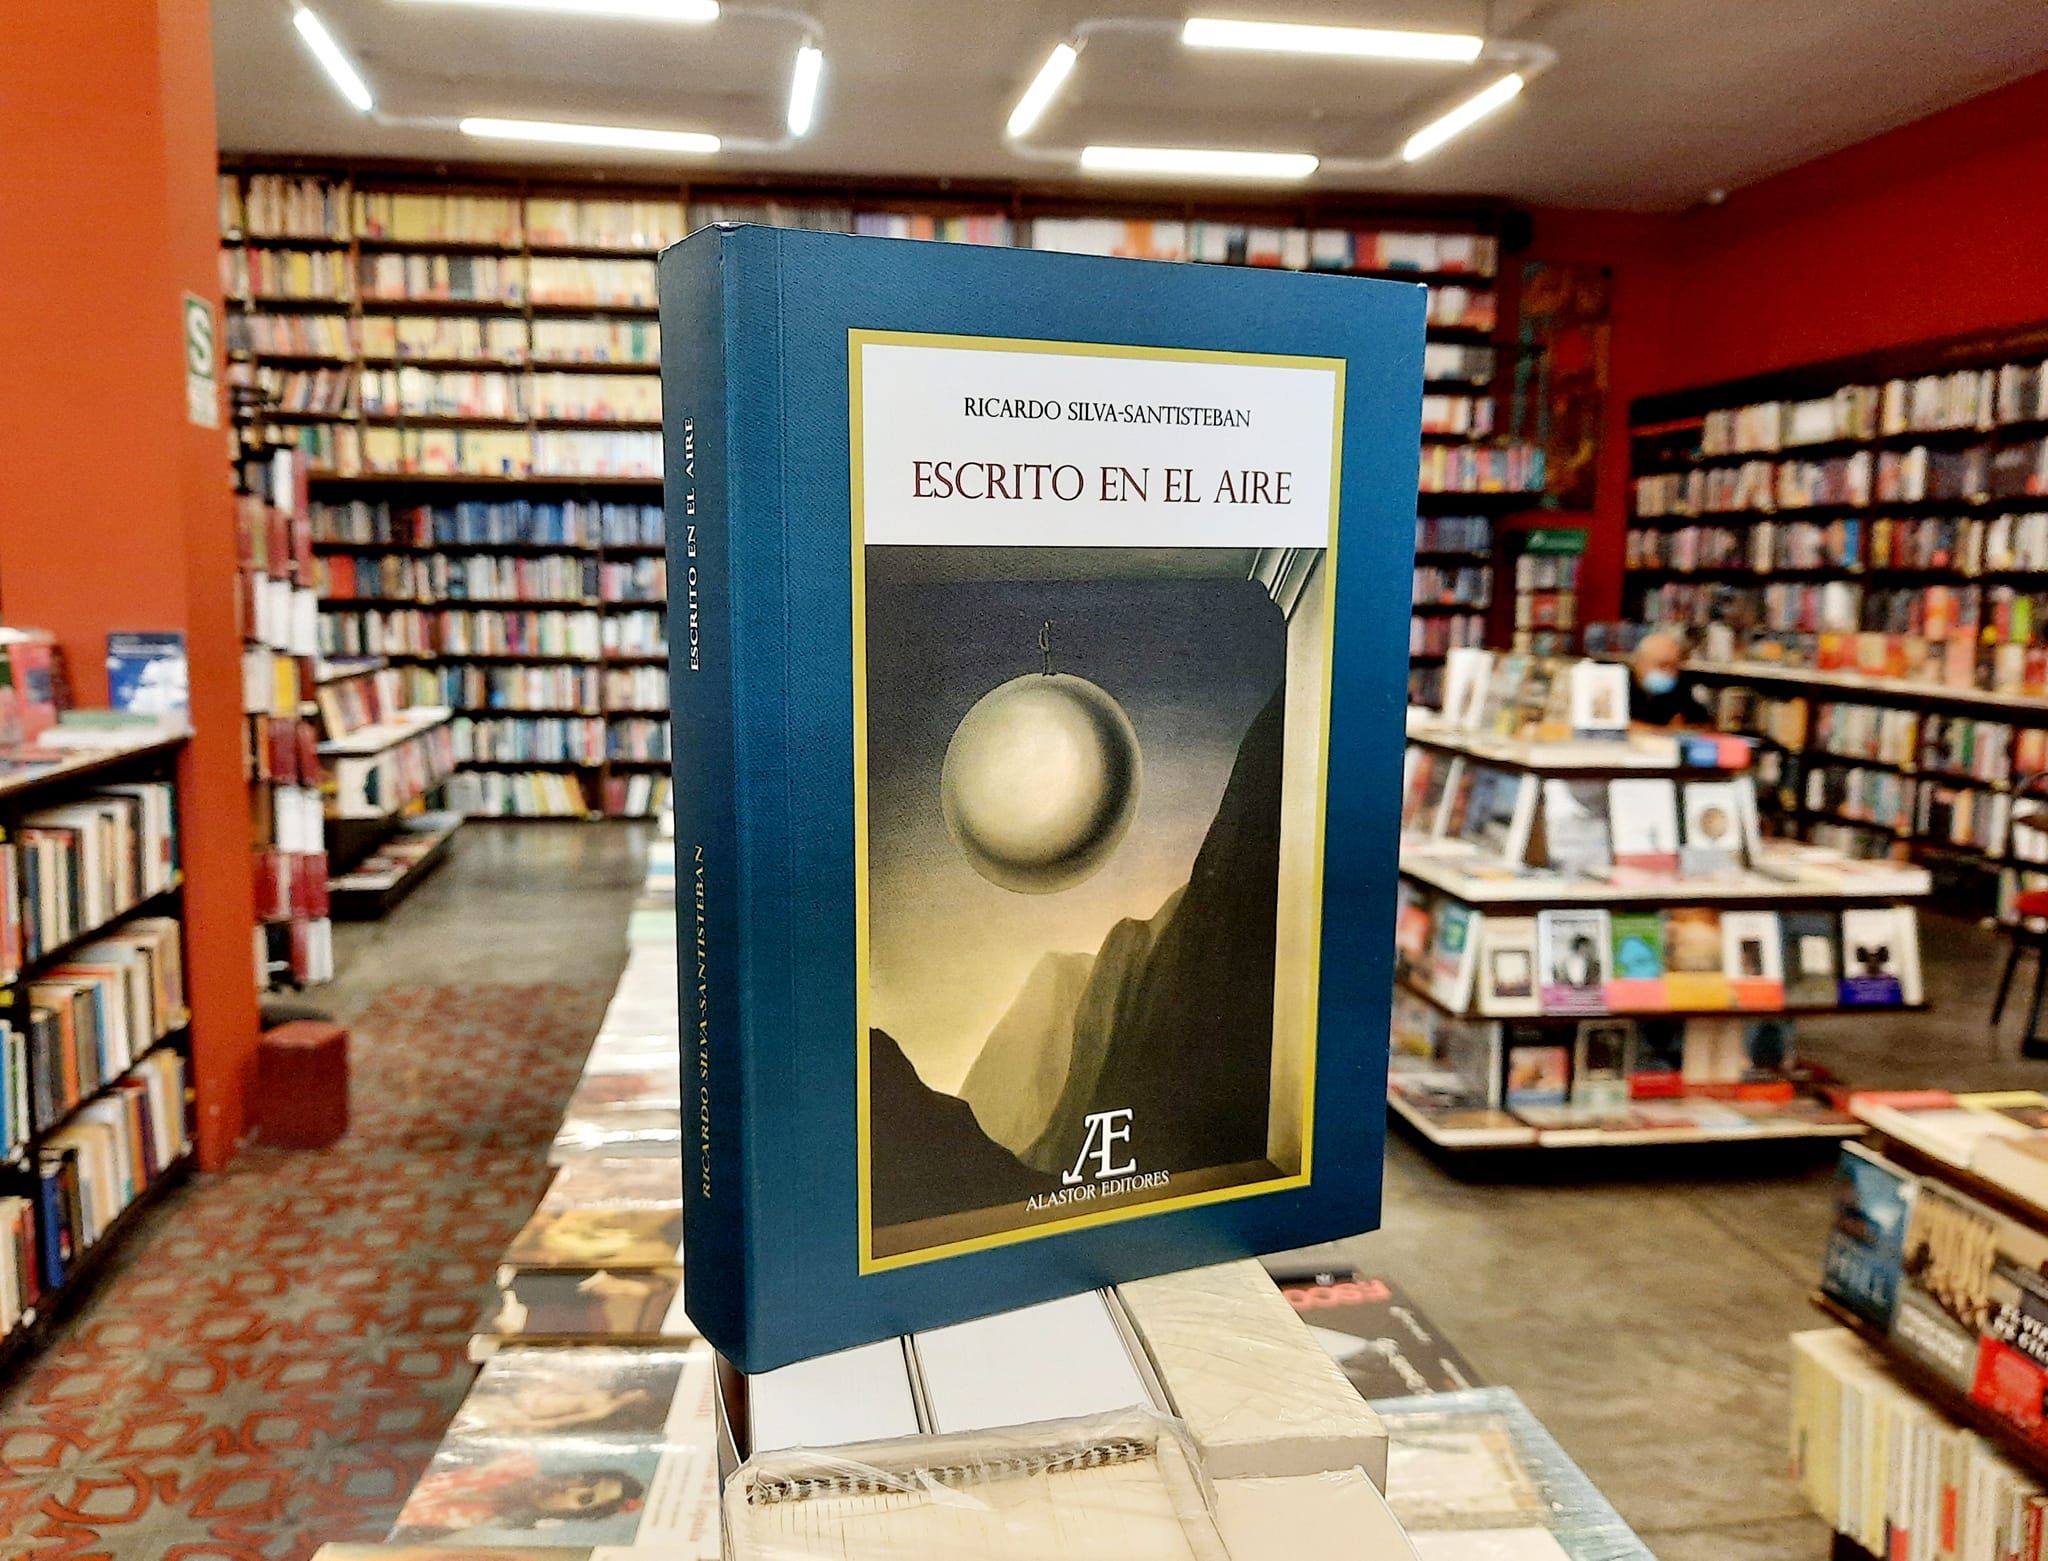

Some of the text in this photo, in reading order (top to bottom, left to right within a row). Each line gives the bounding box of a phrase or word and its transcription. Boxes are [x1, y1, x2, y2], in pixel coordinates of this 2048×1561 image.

[964, 396, 1252, 428] RICARDO SILVA-SANTISTEBAN
[911, 460, 1292, 506] ESCRITO EN EL AIRE
[684, 417, 700, 671] ESCRITO EN EL AIRE
[694, 845, 711, 1199] RICARDO SILVA-SANTISTEBAN
[1025, 1169, 1170, 1212] ALASTOR EDITORES
